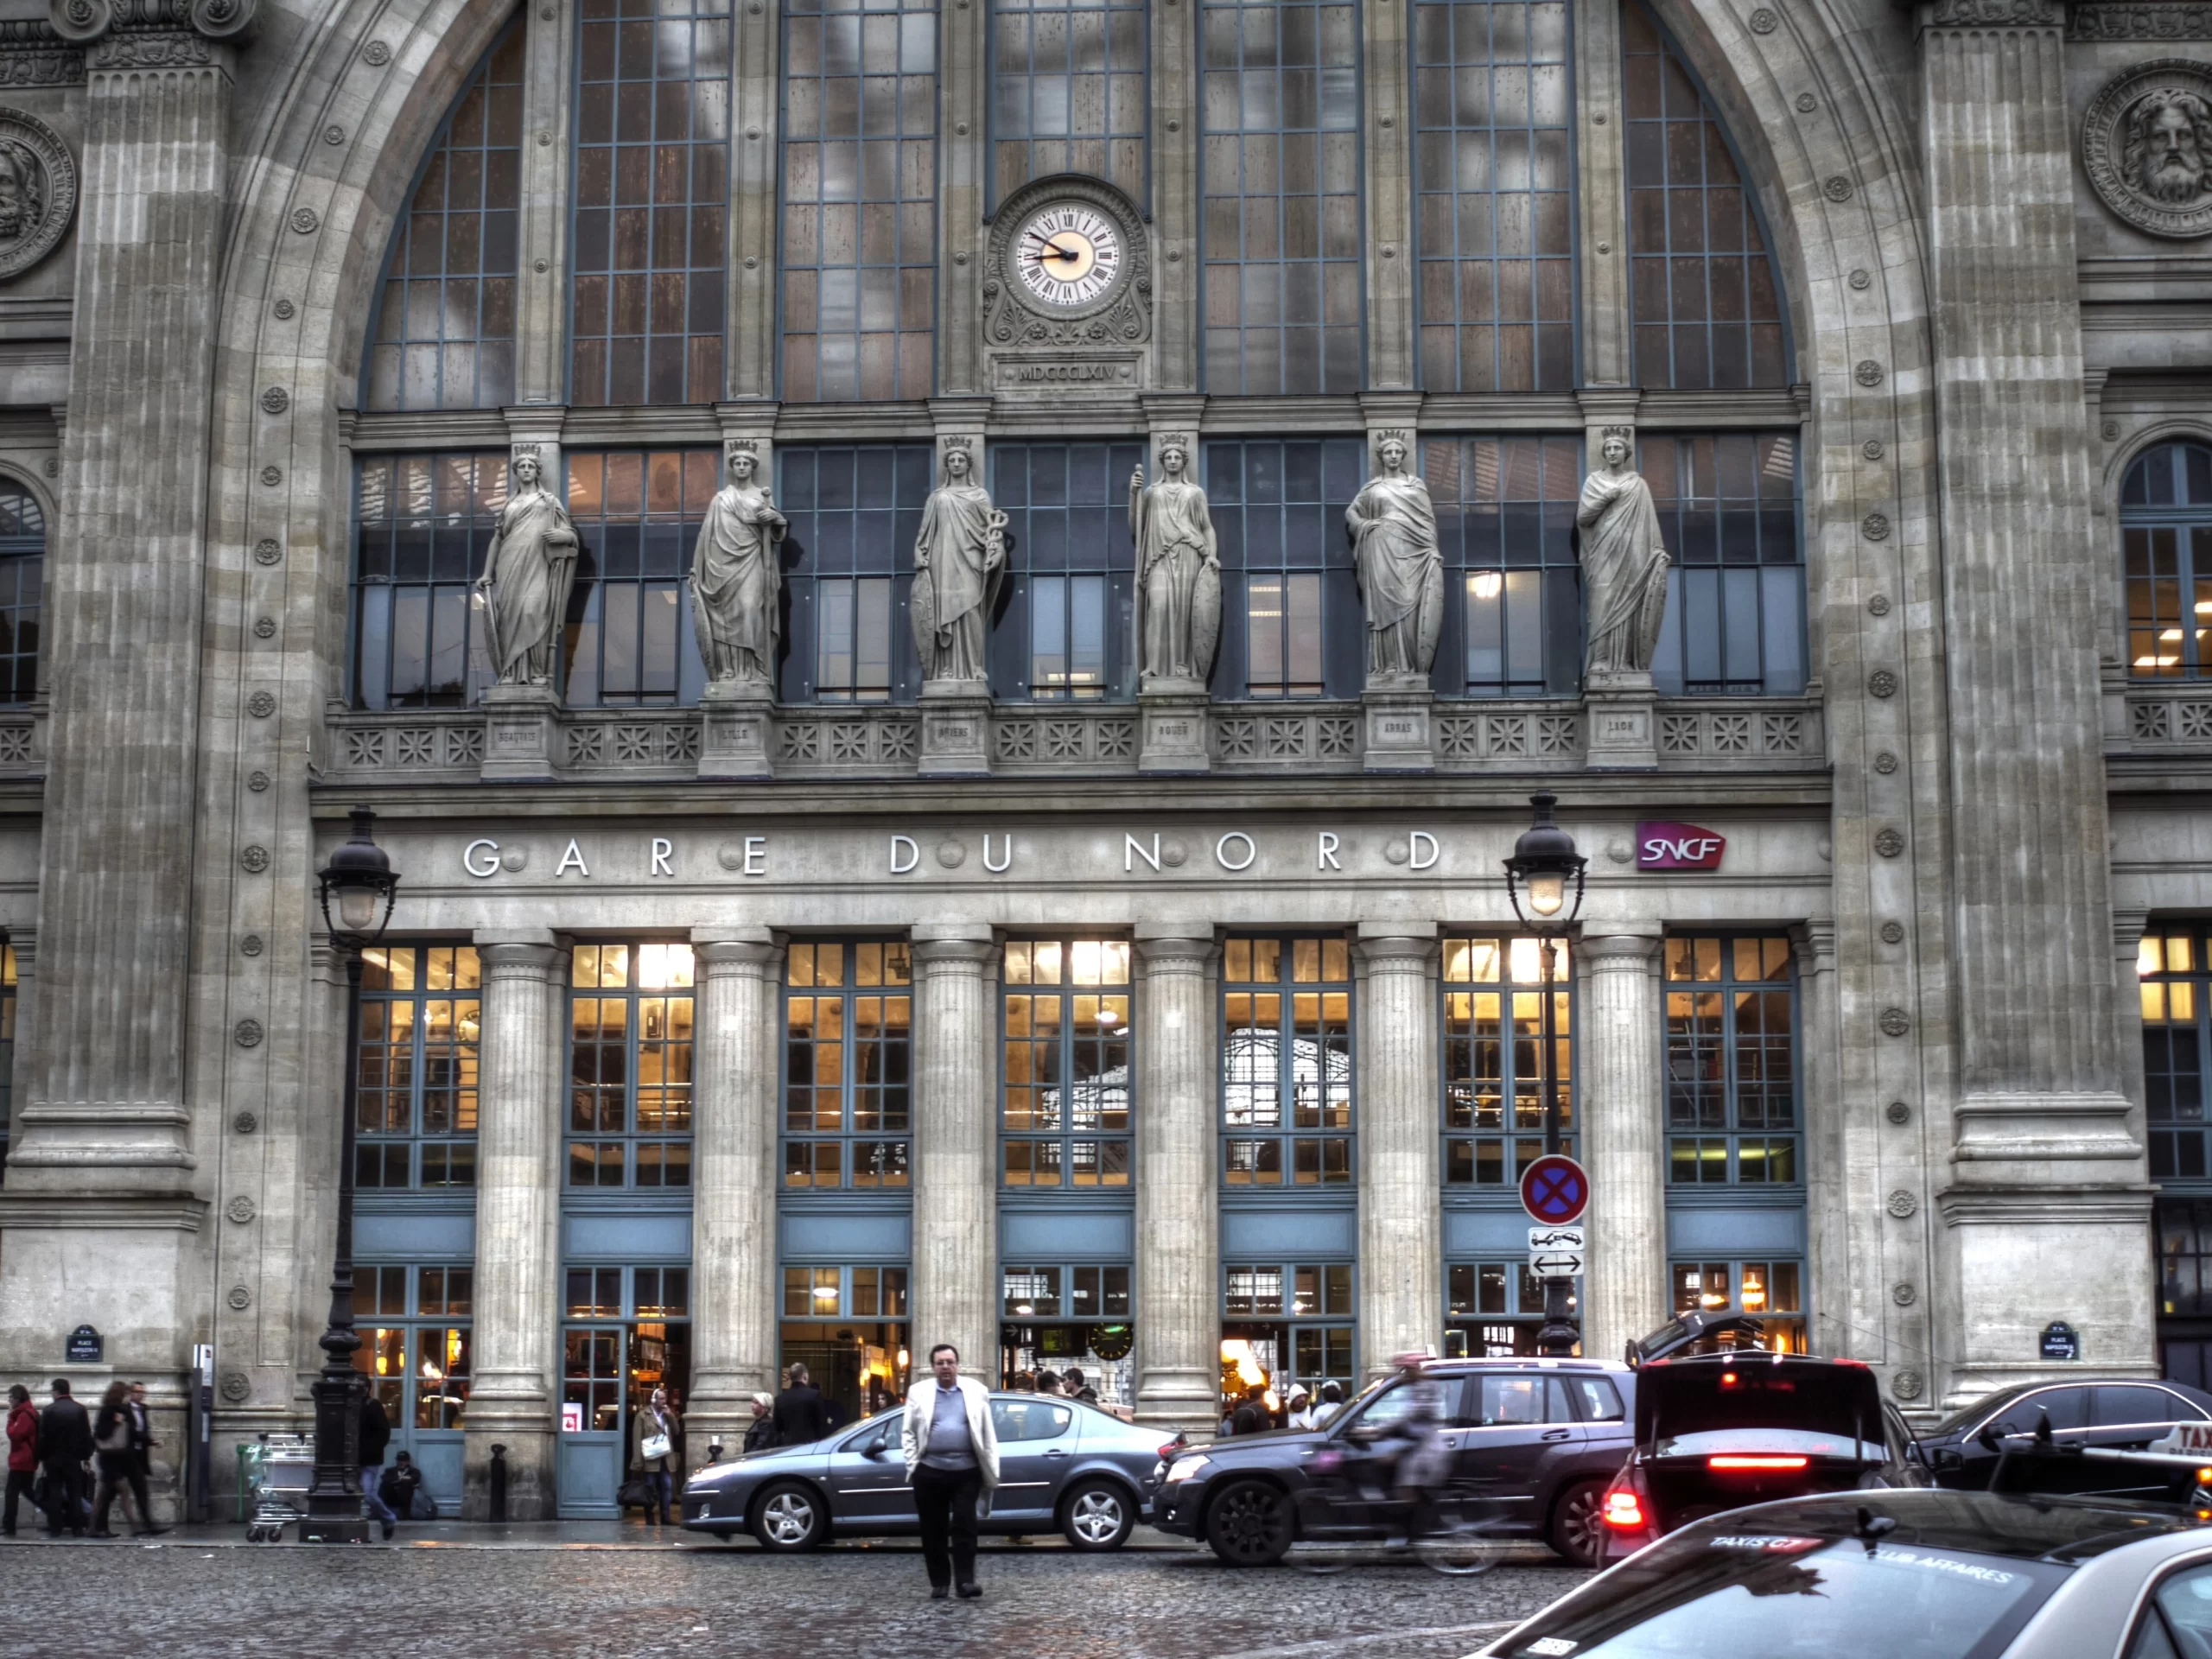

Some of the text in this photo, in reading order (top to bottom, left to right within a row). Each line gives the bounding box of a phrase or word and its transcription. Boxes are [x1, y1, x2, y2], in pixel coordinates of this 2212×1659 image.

[1098, 251, 1112, 260] III
[1019, 365, 1116, 381] MDCCCLXIV
[1385, 723, 1412, 733] ARRAS
[463, 830, 1440, 877] GARE DU NORD
[1641, 838, 1721, 861] SNCF
[1709, 1536, 1802, 1549] TAXIS G7
[1865, 1548, 2013, 1584] CLUB AFFAIRES
